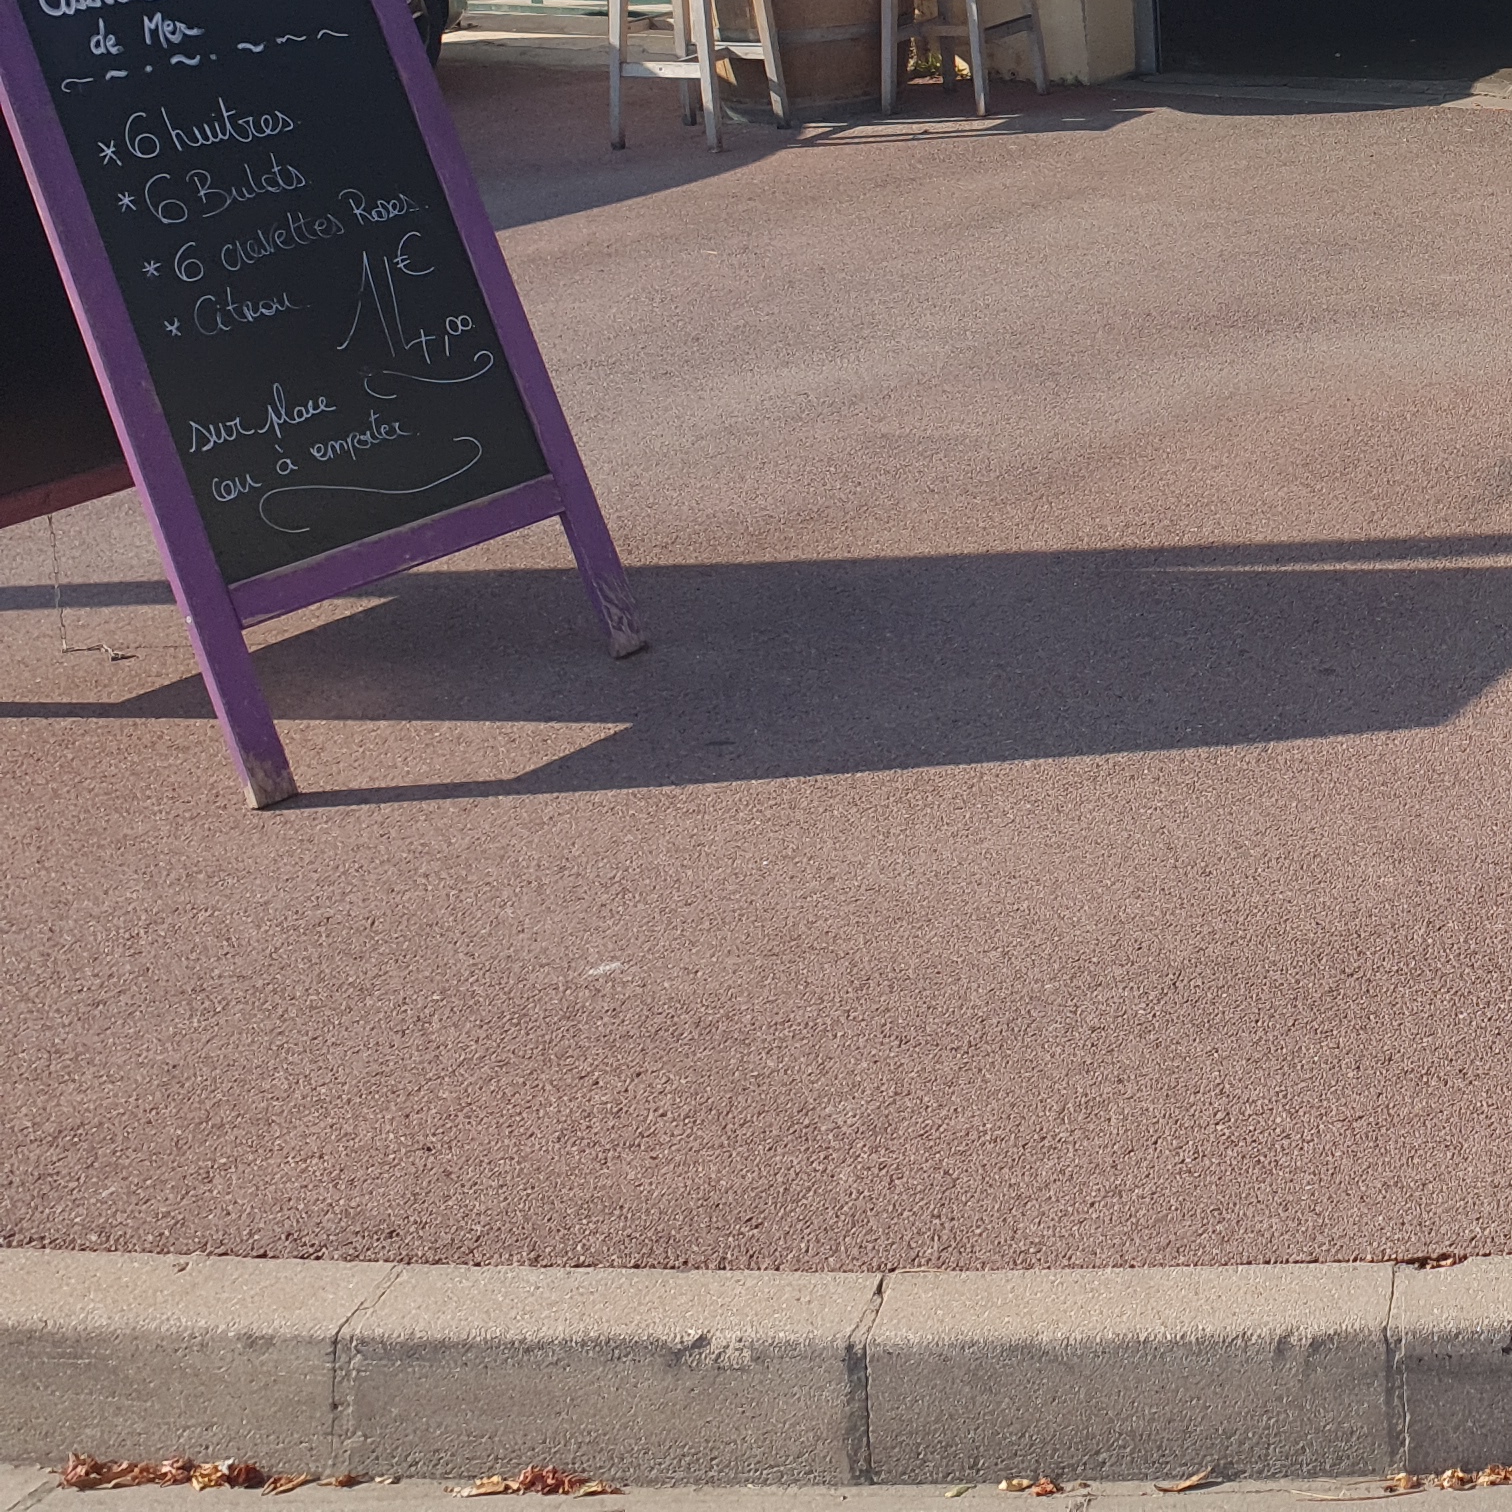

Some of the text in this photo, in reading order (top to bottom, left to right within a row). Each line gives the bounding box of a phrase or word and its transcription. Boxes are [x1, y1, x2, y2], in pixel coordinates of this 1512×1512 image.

[89, 11, 205, 55] de Mer
[125, 111, 160, 159] 6
[145, 174, 188, 224] 6
[175, 241, 204, 282] 6
[189, 416, 255, 453] sur
